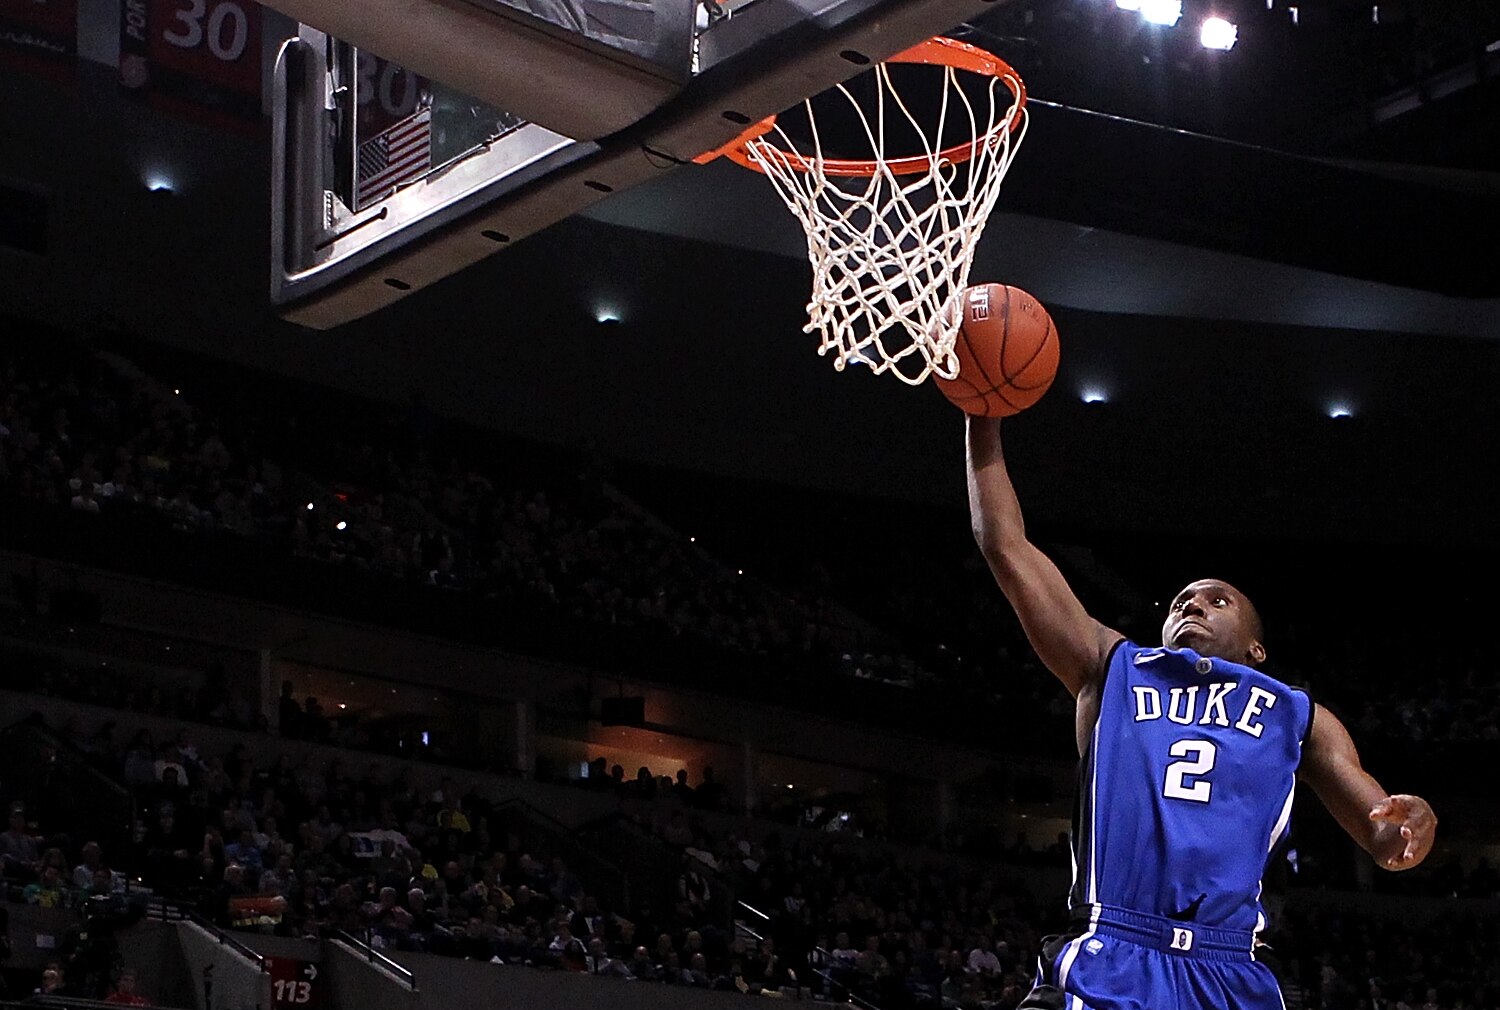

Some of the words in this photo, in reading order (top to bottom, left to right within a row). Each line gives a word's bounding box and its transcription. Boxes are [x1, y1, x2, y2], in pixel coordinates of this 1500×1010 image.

[1132, 682, 1278, 739] DUKE
[1163, 738, 1217, 804] 2
[273, 978, 312, 1004] 113
